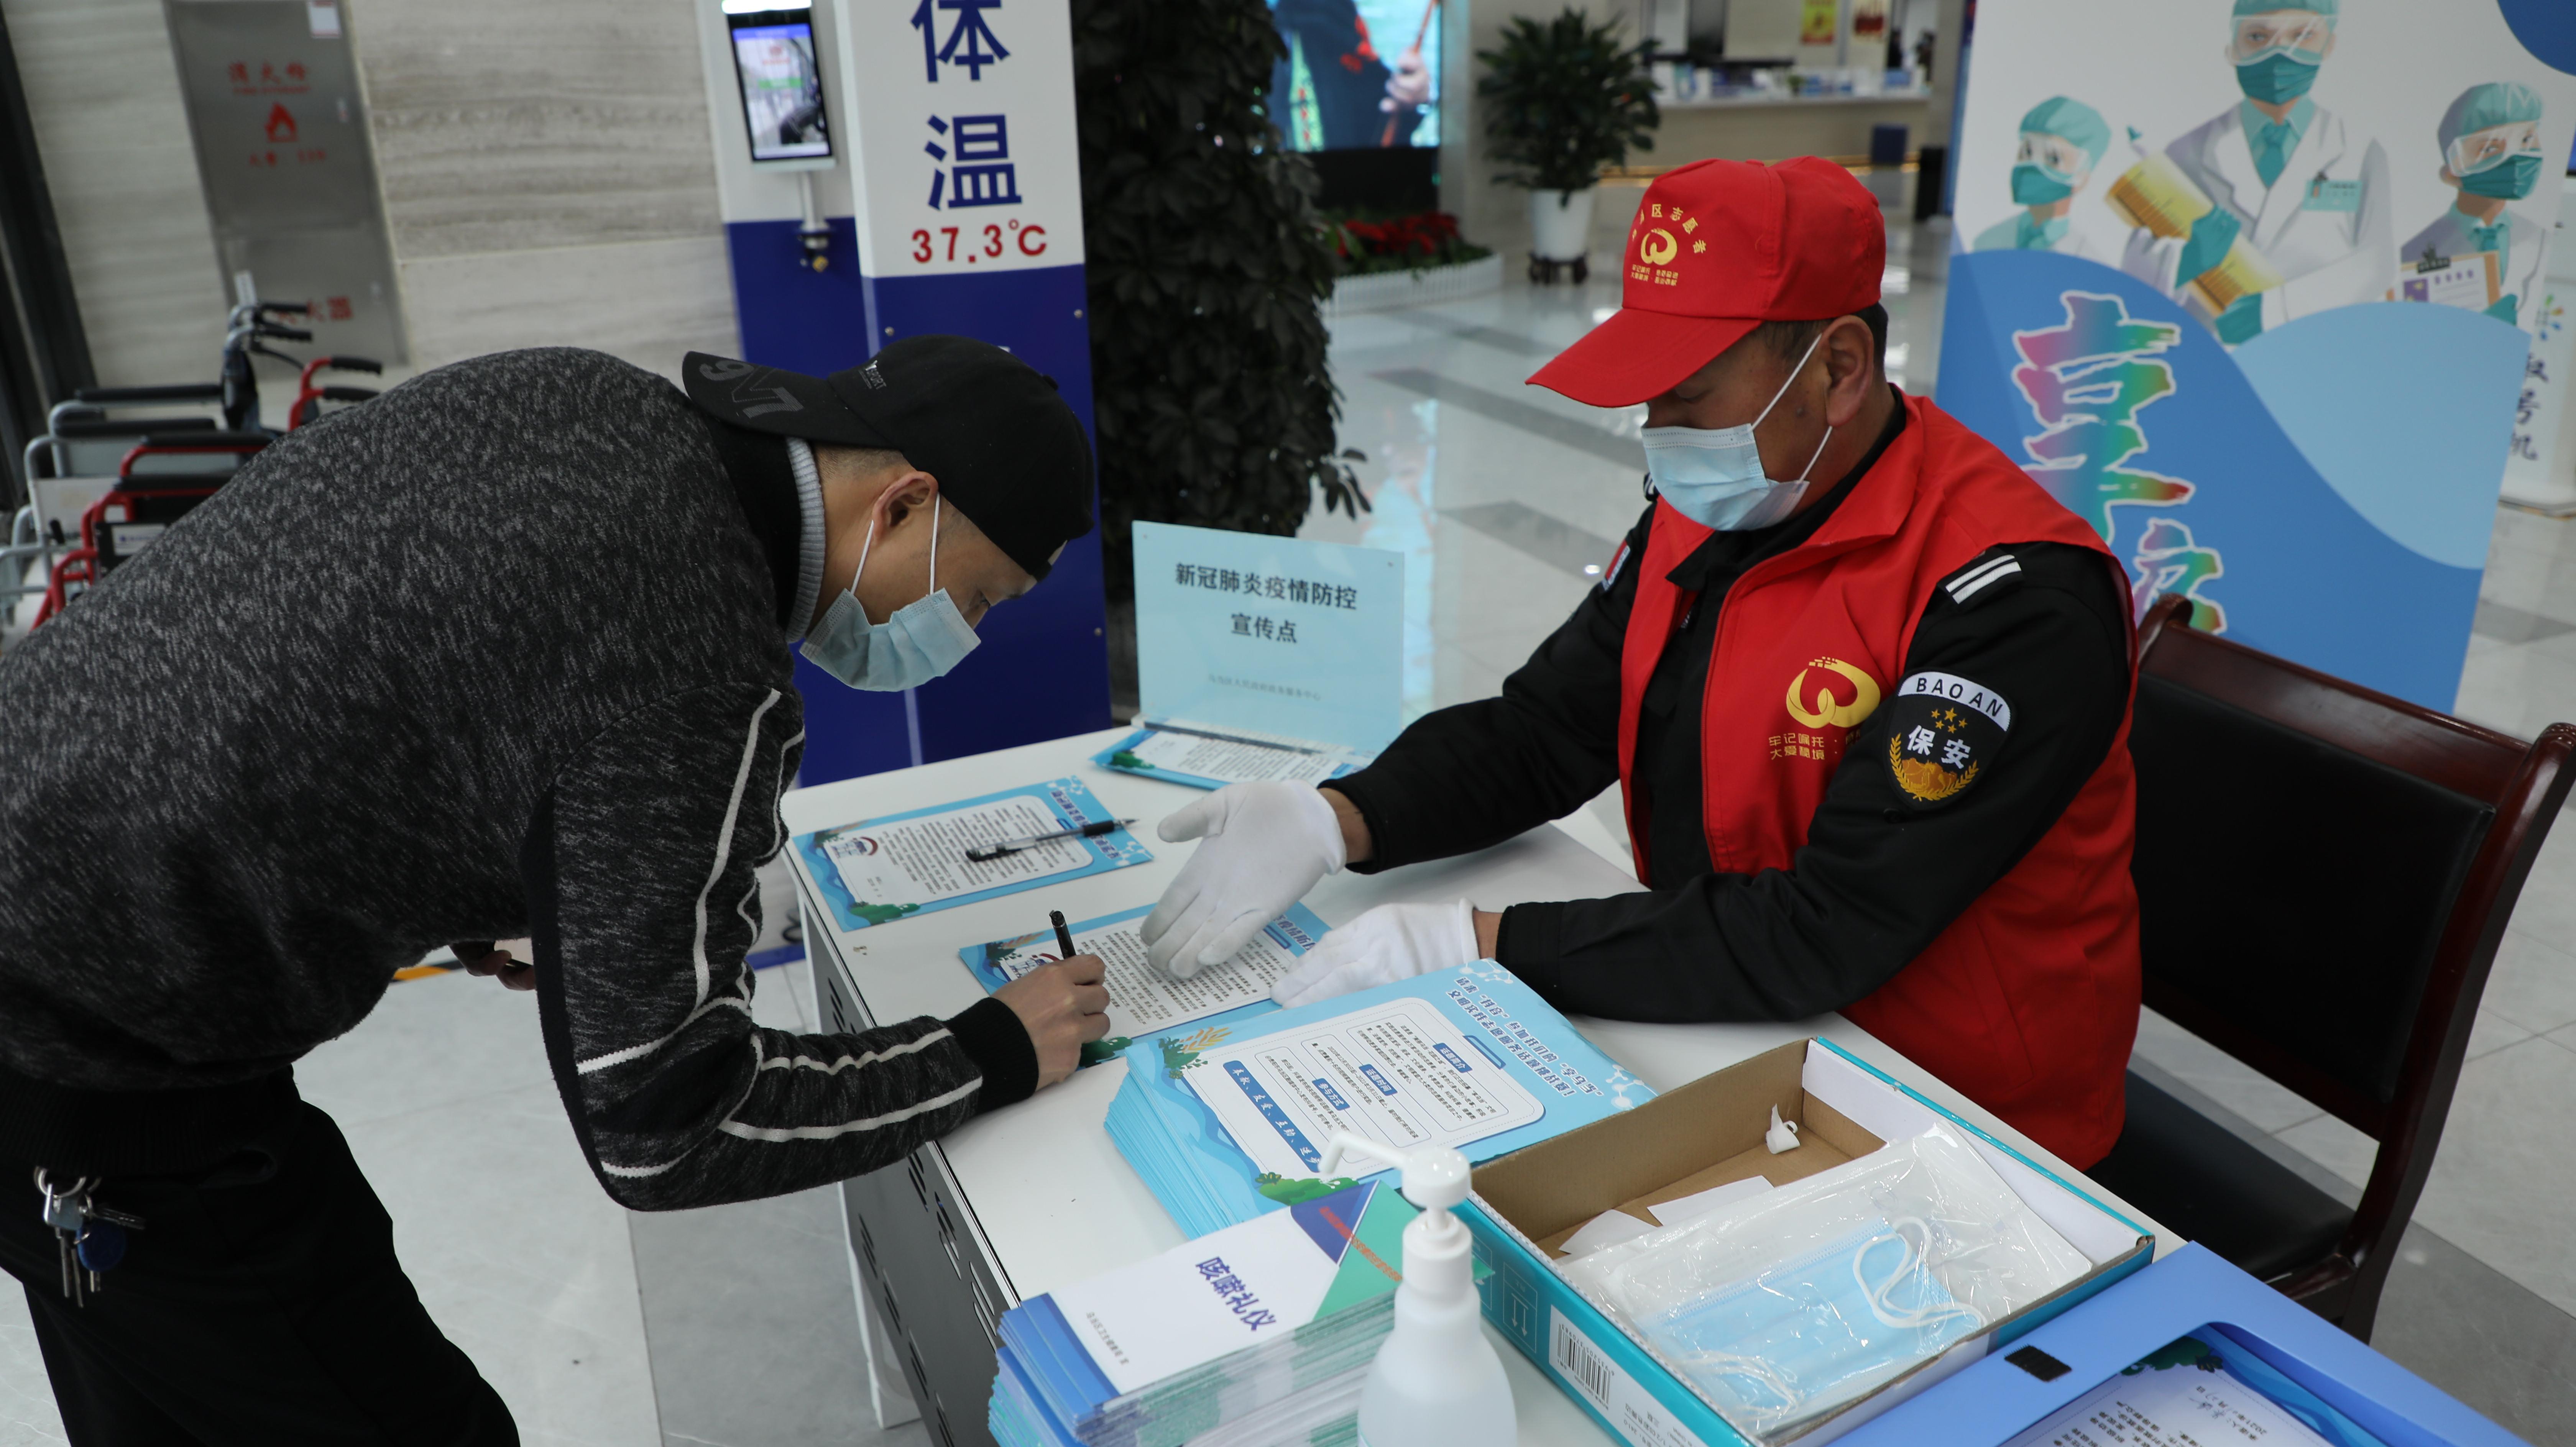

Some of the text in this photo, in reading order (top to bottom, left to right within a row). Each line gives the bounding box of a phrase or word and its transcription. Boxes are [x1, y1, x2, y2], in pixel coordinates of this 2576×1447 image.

[911, 0, 1022, 210] 体温
[1176, 563, 1357, 610] 新冠肺炎疫情防控
[1231, 613, 1297, 643] 宣传点
[1916, 677, 2003, 717] BAO AN
[1907, 725, 1971, 769] 保安
[1438, 1047, 1468, 1069] 话题简介
[1316, 1082, 1345, 1106] 参与方式
[1364, 1068, 1393, 1092] 话题时间
[1196, 1256, 1276, 1331] 咳嗽礼仪
